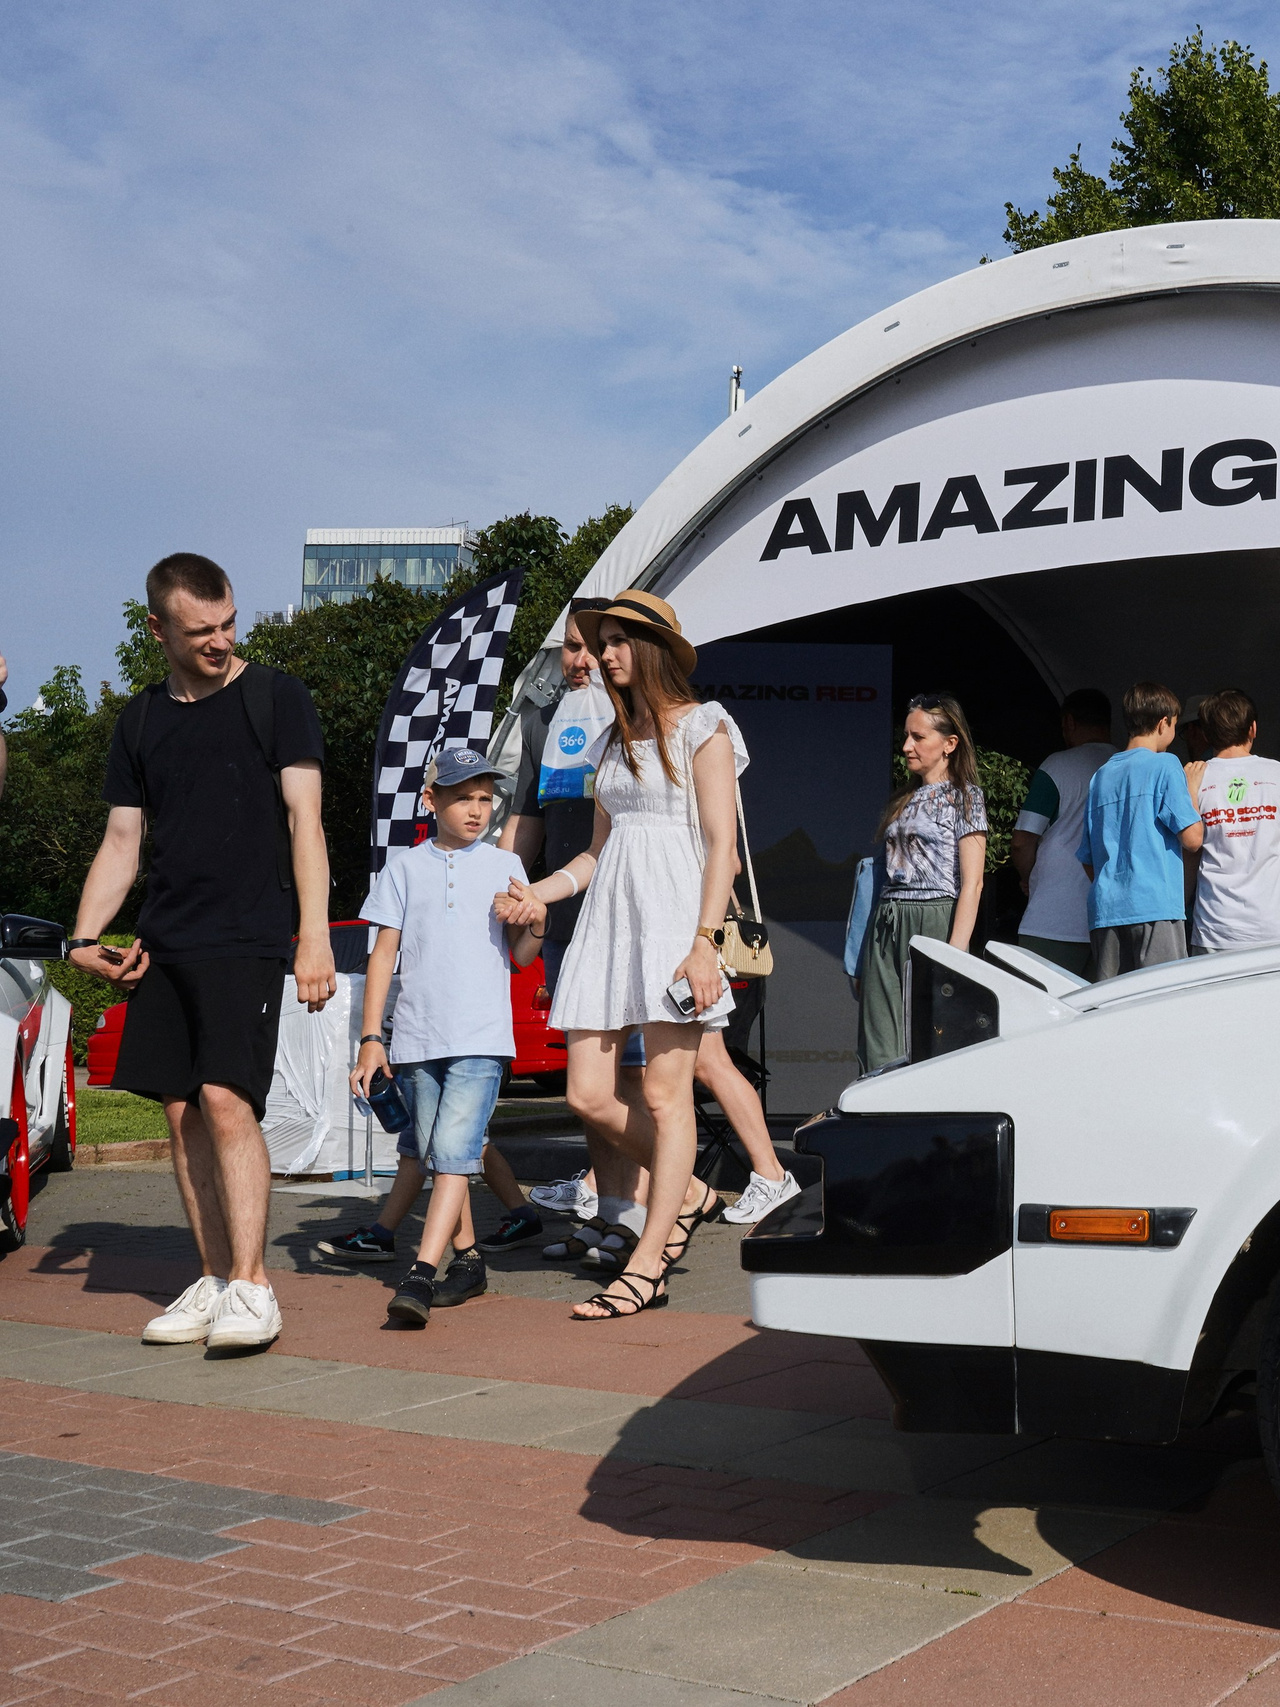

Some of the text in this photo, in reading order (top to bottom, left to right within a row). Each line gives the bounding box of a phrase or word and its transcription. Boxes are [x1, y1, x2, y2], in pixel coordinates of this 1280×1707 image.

[759, 438, 1278, 562] AMAZING
[691, 684, 878, 702] MAZING RED
[1201, 805, 1277, 820] rolling stones
[1238, 814, 1275, 822] diamonds
[747, 1049, 858, 1063] SPEEDCA
